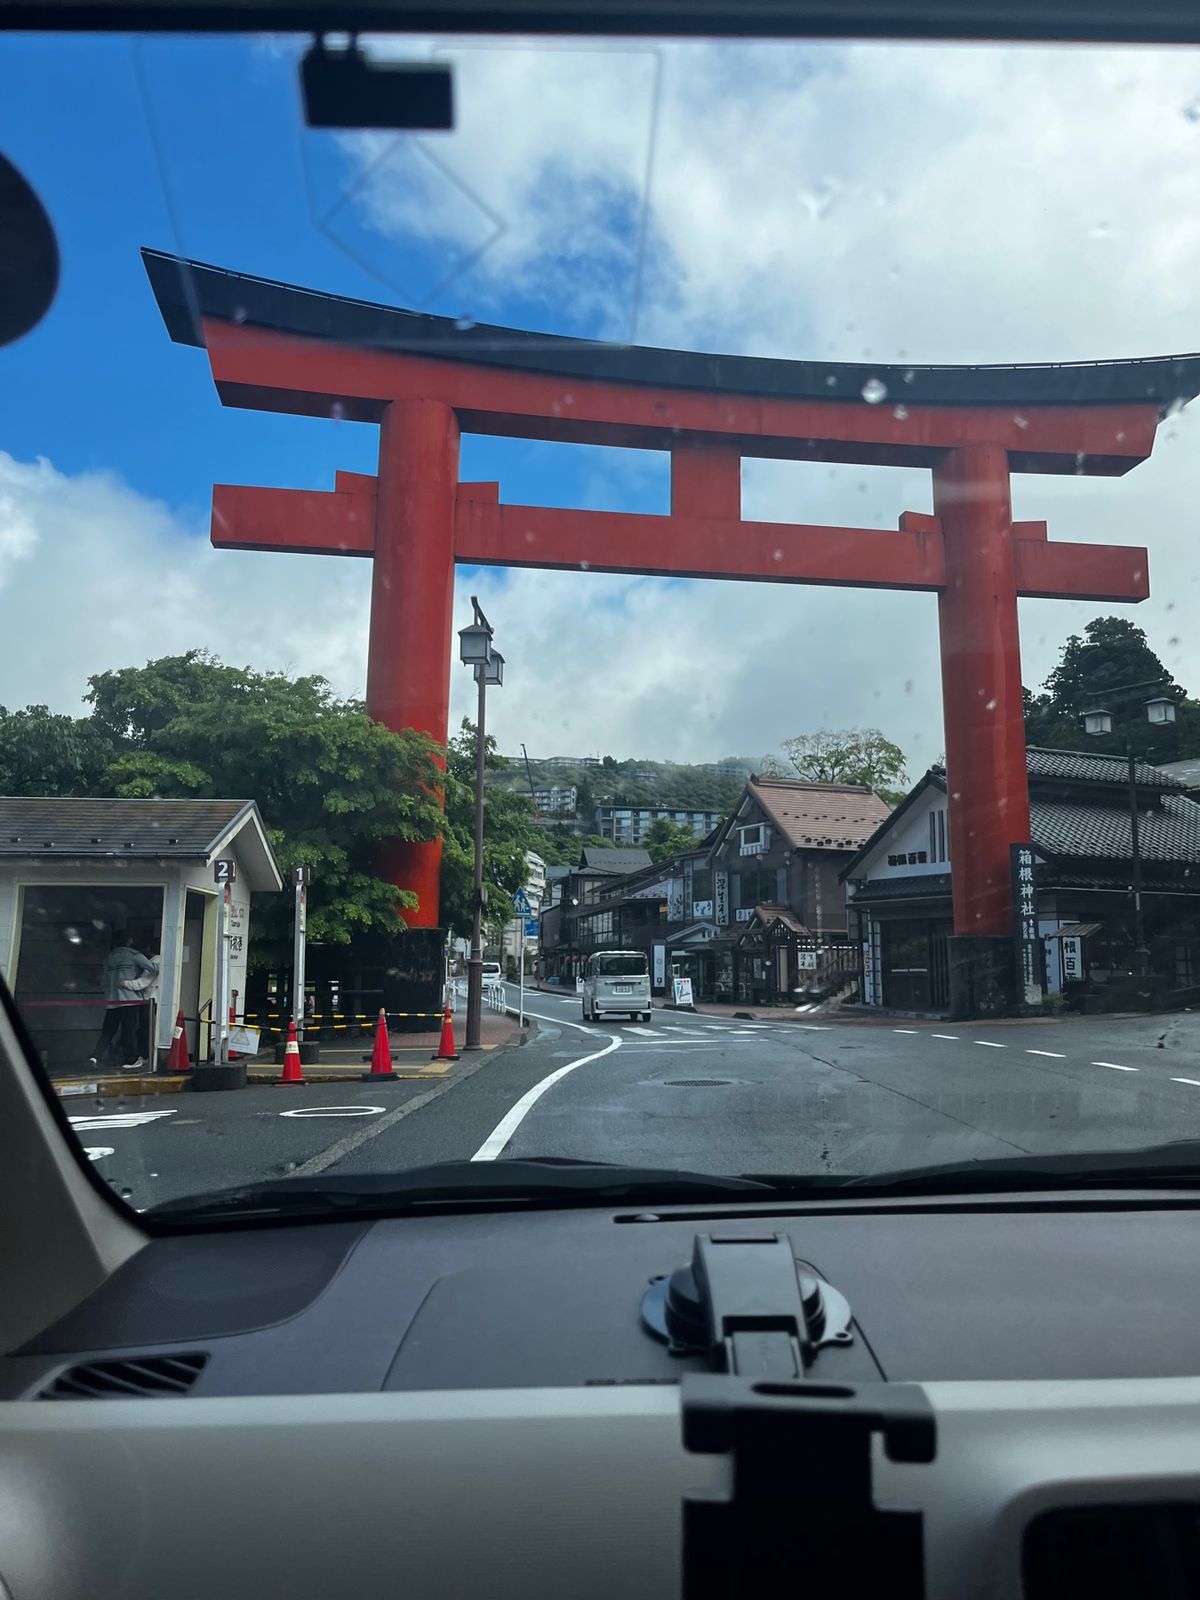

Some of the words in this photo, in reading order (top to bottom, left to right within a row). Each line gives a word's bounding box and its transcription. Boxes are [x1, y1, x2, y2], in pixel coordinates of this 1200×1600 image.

[218, 862, 229, 876] 2
[296, 868, 303, 881] 1
[1018, 849, 1036, 916] 箱根神社
